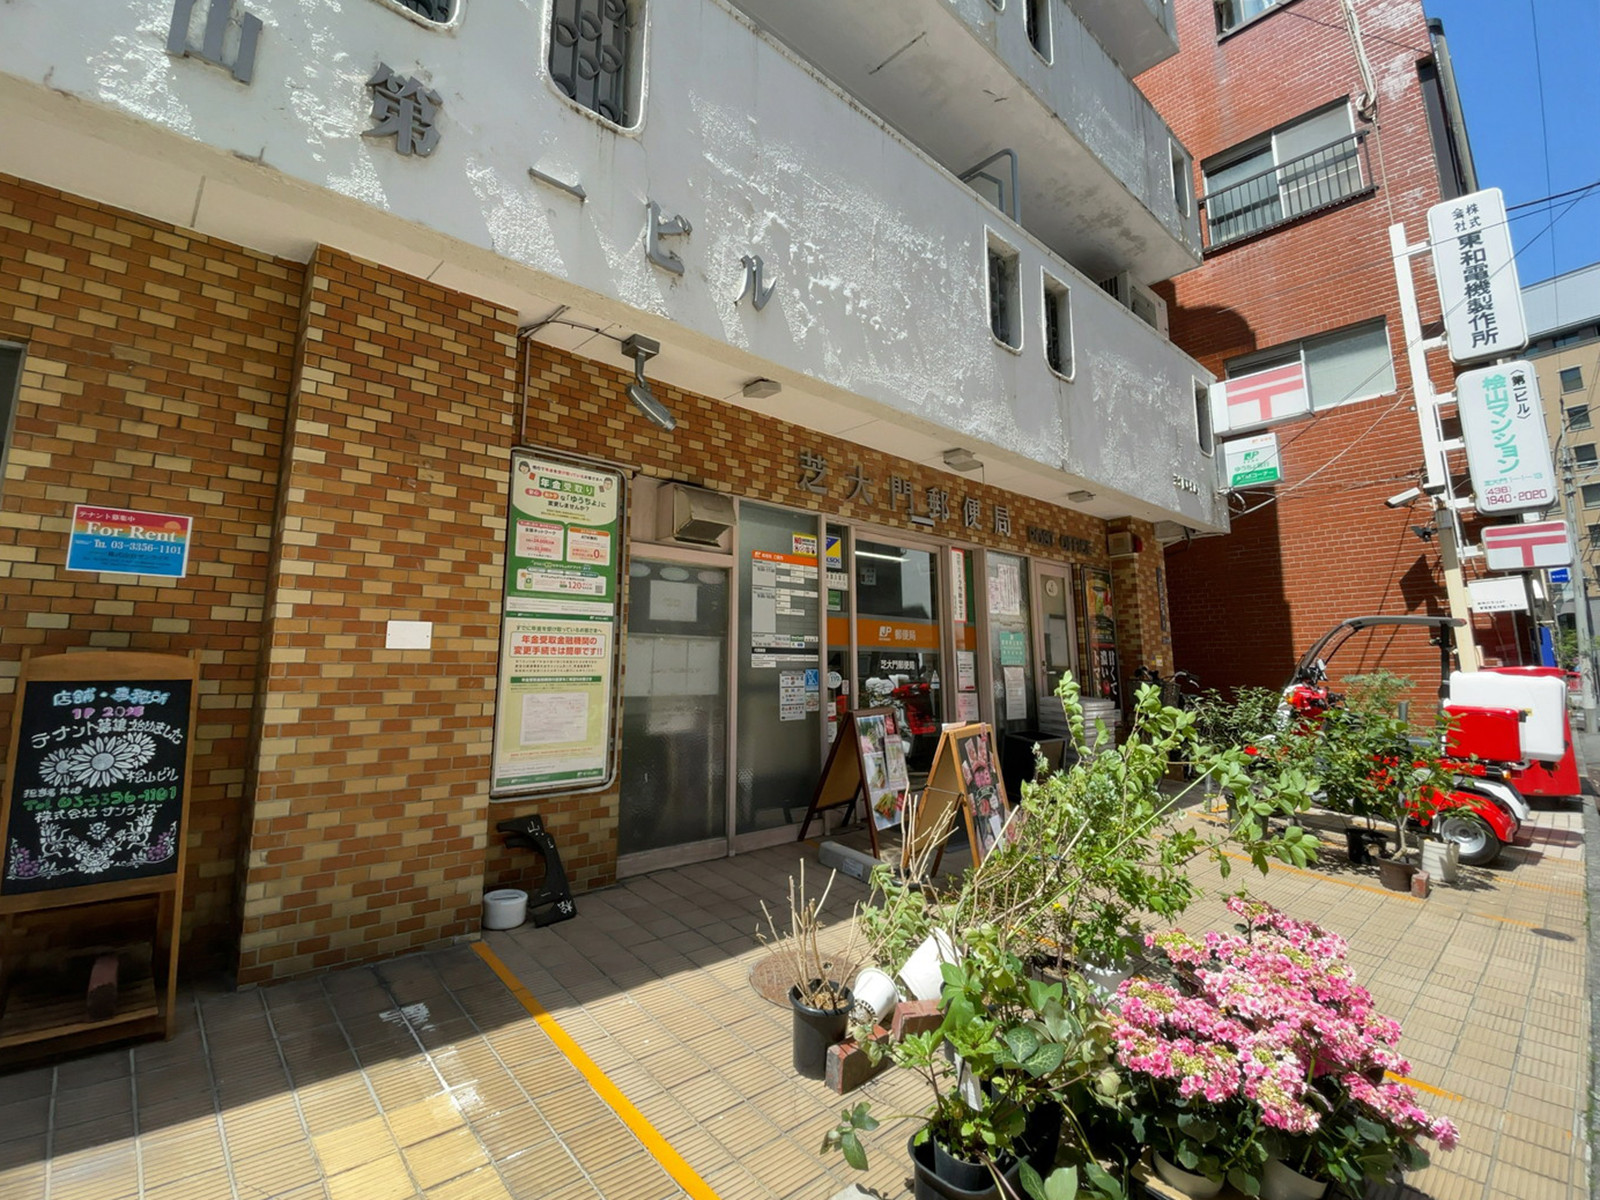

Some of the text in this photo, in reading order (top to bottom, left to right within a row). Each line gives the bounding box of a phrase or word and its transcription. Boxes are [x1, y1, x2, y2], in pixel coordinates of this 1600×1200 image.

[1457, 230, 1499, 348] 東和電機製作所
[1482, 374, 1520, 474] 桧山マンション
[540, 477, 594, 495] 年金受取り
[799, 450, 1012, 537] 芝大門郵便局
[80, 511, 135, 522] テナント募集中
[86, 521, 177, 542] For Rent
[111, 540, 181, 554] 03-3356-1101
[521, 635, 597, 646] 年金受取金融機関の
[894, 628, 917, 641] 郵便局
[880, 659, 915, 670] 芝大門郵便局
[35, 808, 98, 823] 株式会社
